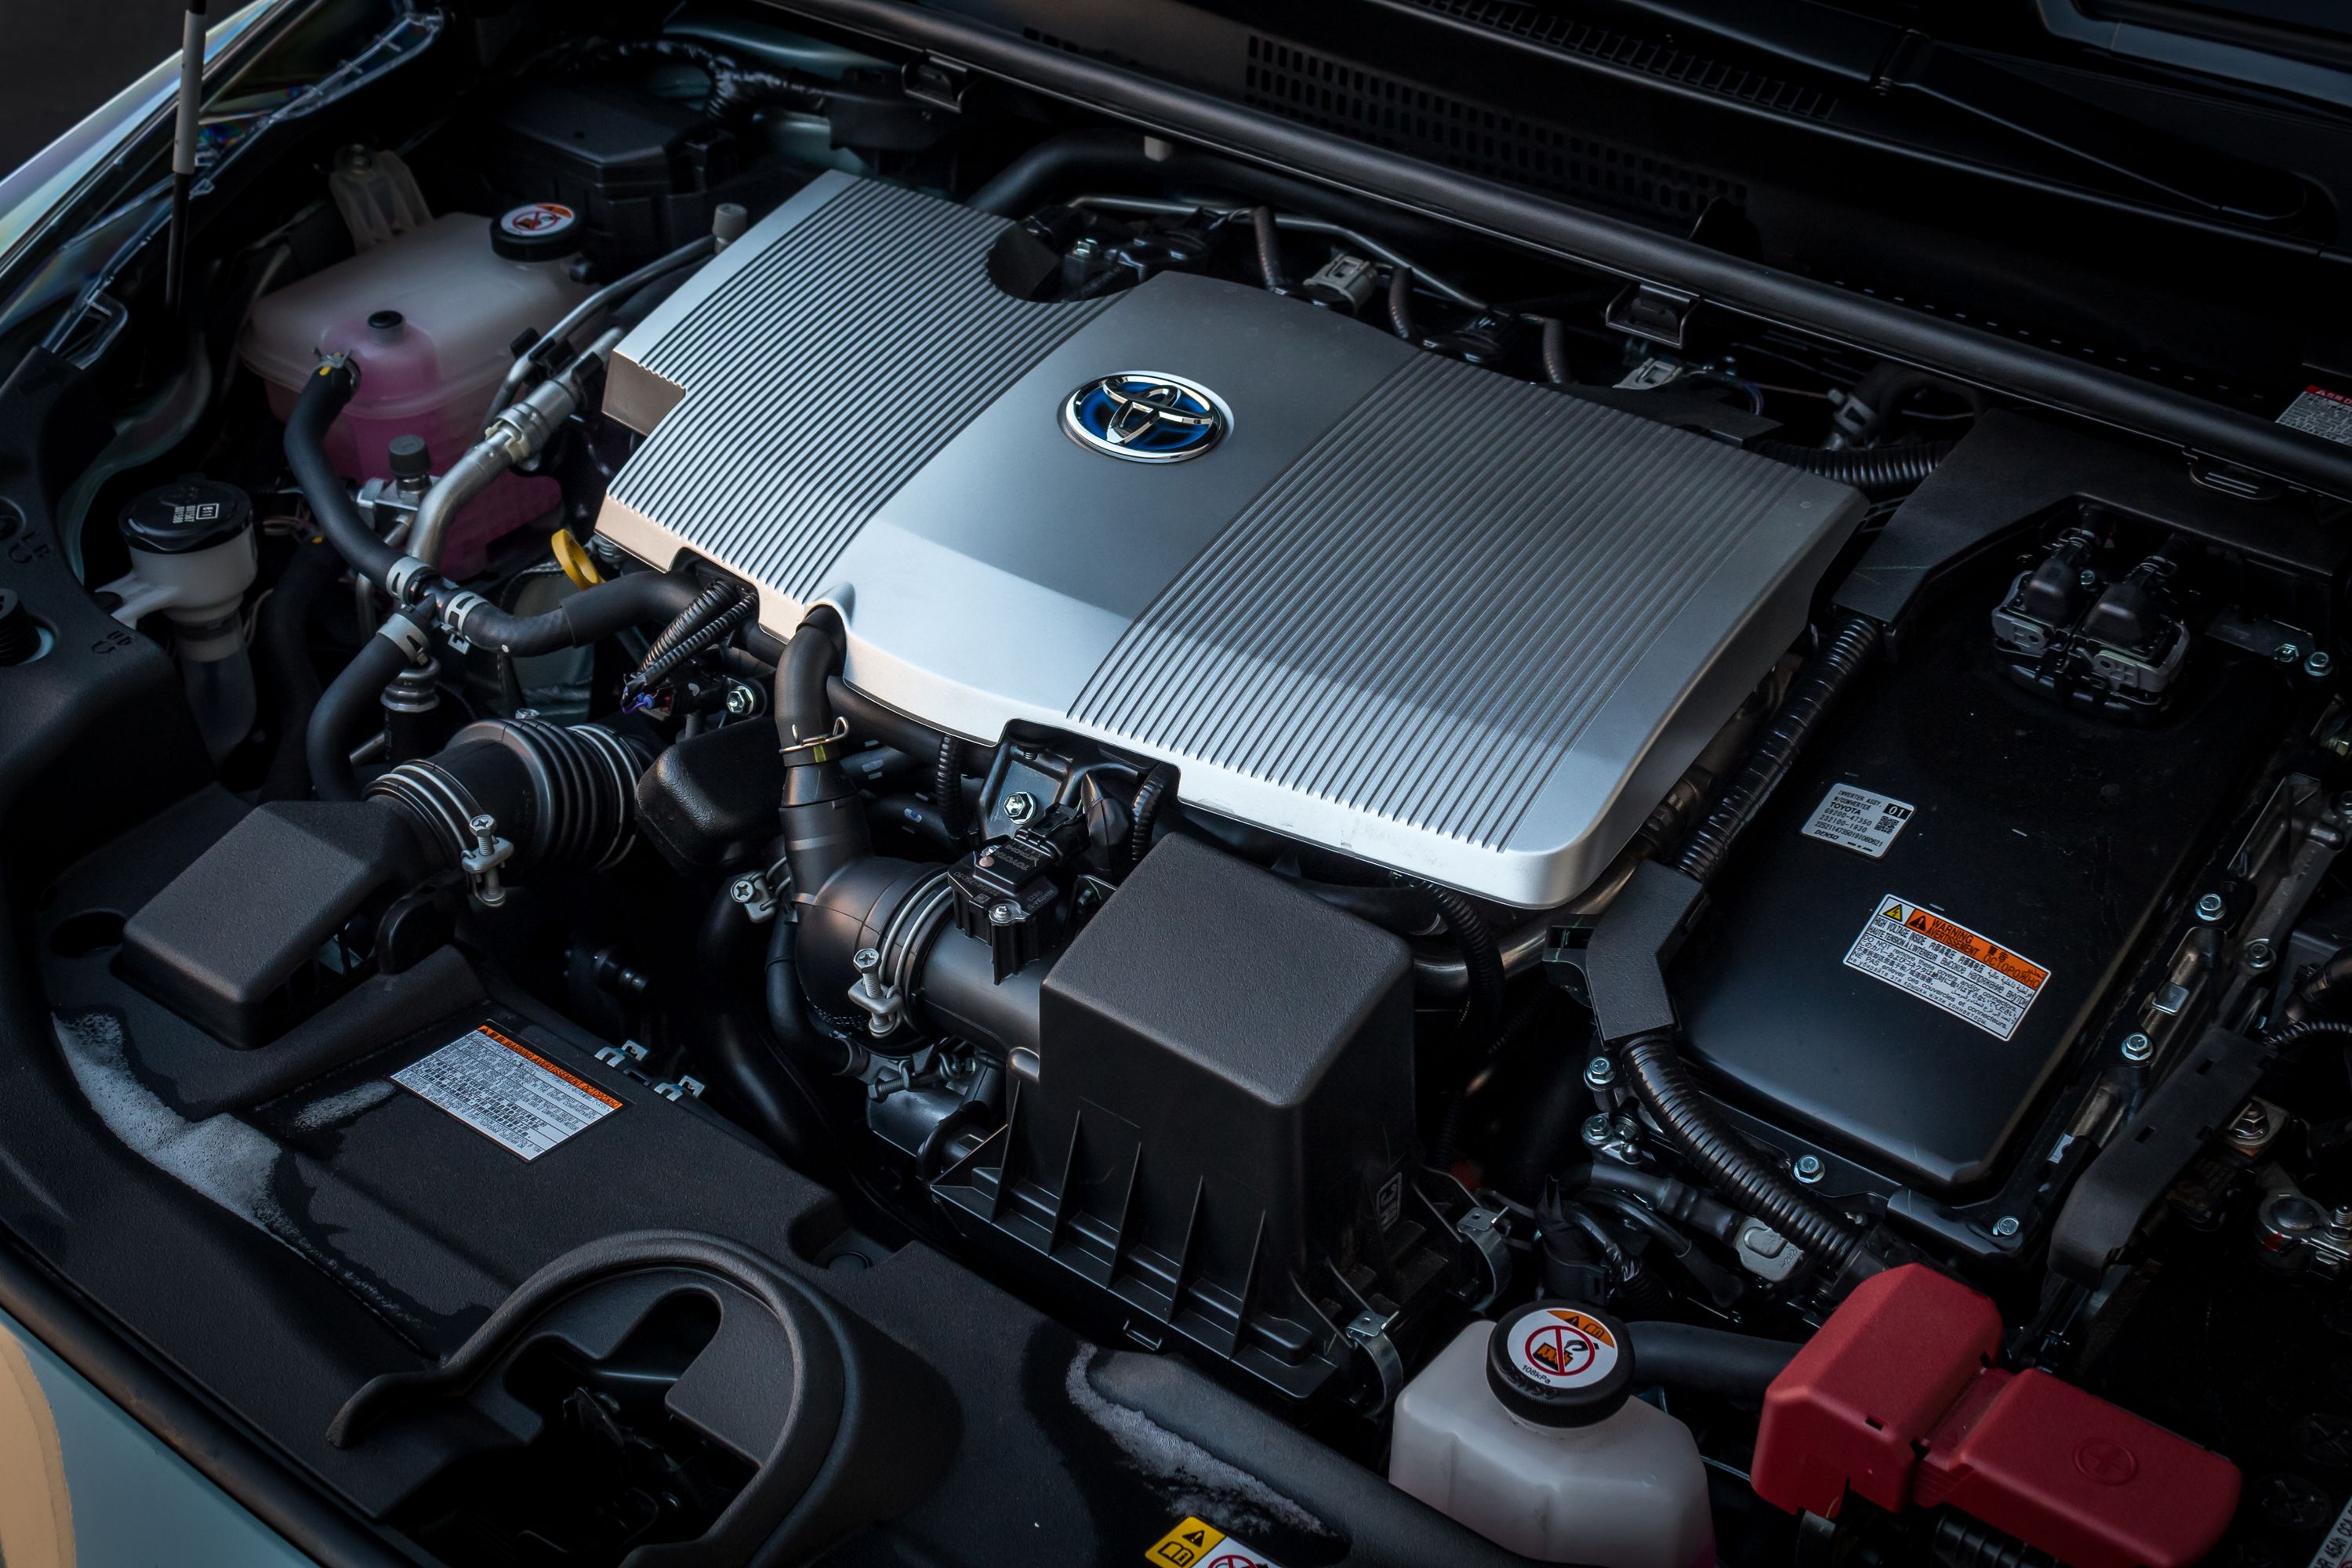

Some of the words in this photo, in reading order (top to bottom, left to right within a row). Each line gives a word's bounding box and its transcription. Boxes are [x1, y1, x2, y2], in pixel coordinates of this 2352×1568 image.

[1828, 801, 1862, 815] TOYOTA
[1833, 795, 1871, 810] W/CONVERTER
[1837, 789, 1864, 801] INVERTER
[1865, 798, 1883, 807] ASSY.
[1887, 805, 1904, 817] 01
[1819, 814, 1867, 833] 232100-1930
[1813, 829, 1839, 840] DENSO
[1867, 924, 1886, 938] HAUTE
[1883, 931, 1906, 946] TENSION
[1872, 915, 1888, 927] HIGH
[1886, 921, 1910, 938] VOLTAGE
[1908, 931, 1926, 945] INSIDE
[1925, 925, 1980, 956] AVERTISSEMENT
[1930, 918, 1974, 944] WARNING
[1862, 934, 1875, 943] DO
[1875, 939, 1890, 950] NOT
[1892, 947, 1916, 961] remove
[1917, 959, 1936, 971] these
[1936, 968, 1958, 982] covers
[1959, 979, 1980, 993] and/or
[1981, 990, 2018, 1011] connectors.
[1981, 954, 2042, 988] ОСТОРОЖНО
[1852, 949, 1864, 959] NE
[1864, 956, 1880, 966] PAS
[1881, 963, 1906, 978] enlever
[1906, 975, 1919, 985] ces
[1920, 982, 1956, 1003] couvercles
[1965, 1004, 2010, 1029] connecteurs.
[503, 1040, 535, 1058] WARNING
[531, 1057, 583, 1086] AVERTISSEMENT
[1522, 1364, 1551, 1385] 108kPa
